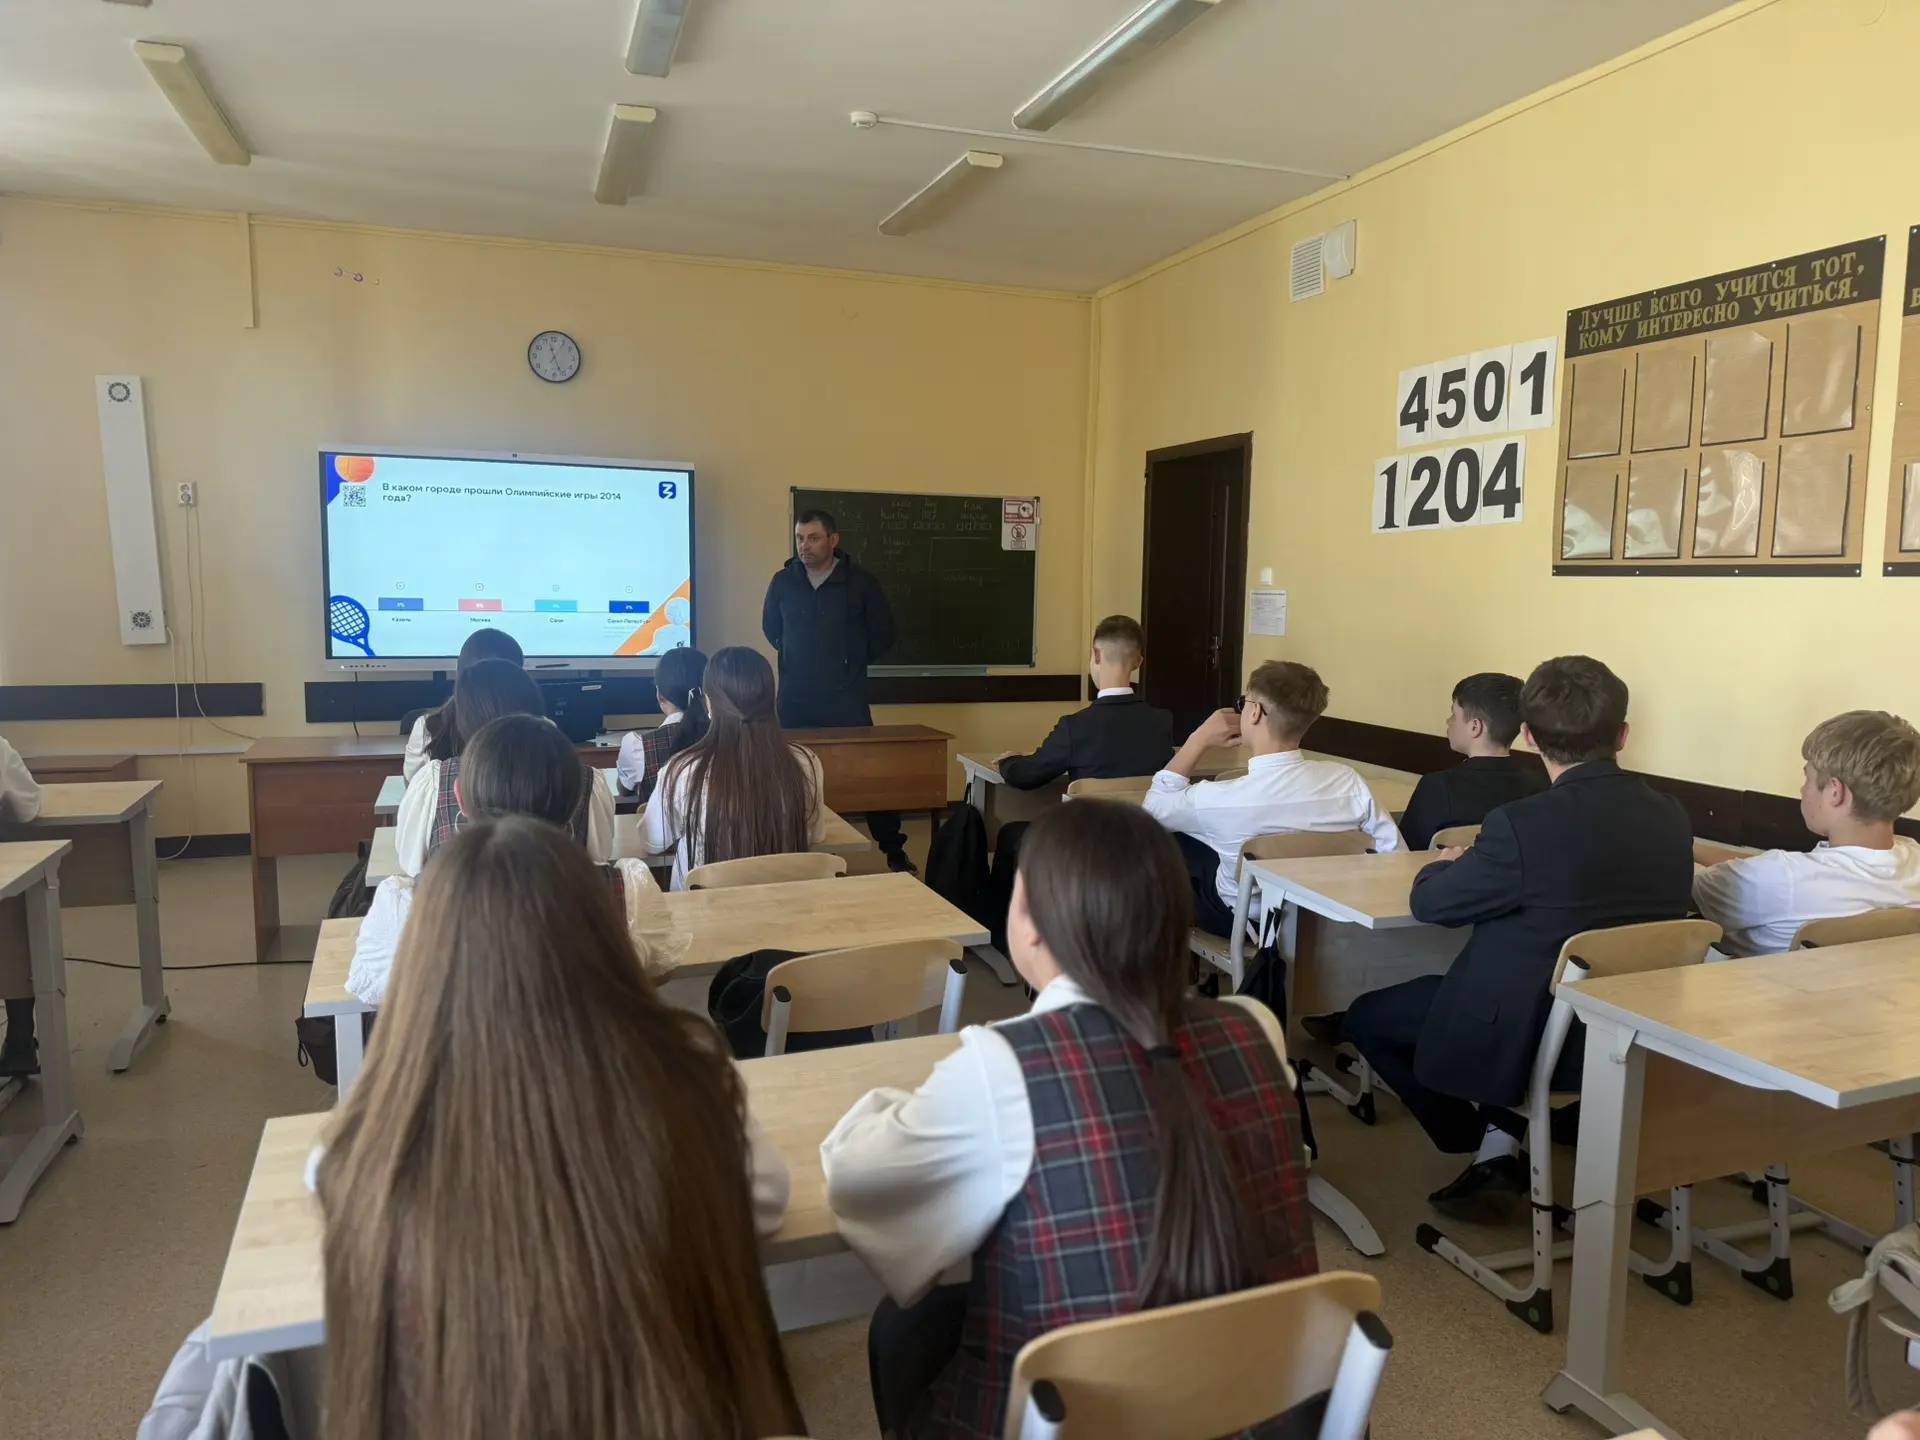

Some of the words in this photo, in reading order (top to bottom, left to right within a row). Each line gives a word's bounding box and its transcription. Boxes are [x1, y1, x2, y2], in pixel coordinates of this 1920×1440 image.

[1579, 302, 1642, 331] ЛУЧШЕ
[1650, 288, 1702, 316] ВСЕГО
[1716, 265, 1796, 300] УЧИТСЯ
[1811, 252, 1865, 279] ТОТ,
[1579, 326, 1627, 350] КОМУ
[1637, 302, 1740, 339] ИНТЕРЕСНО
[1754, 276, 1859, 315] УЧИТЬСЯ.
[1400, 350, 1548, 433] 4501
[383, 483, 389, 491] В
[392, 484, 423, 492] каком
[425, 486, 462, 495] городе
[464, 487, 503, 496] прошли
[505, 487, 572, 498] Олимпийские
[574, 492, 598, 501] игры
[600, 492, 621, 500] 2014
[383, 493, 411, 502] года?
[1378, 442, 1521, 530] 1204
